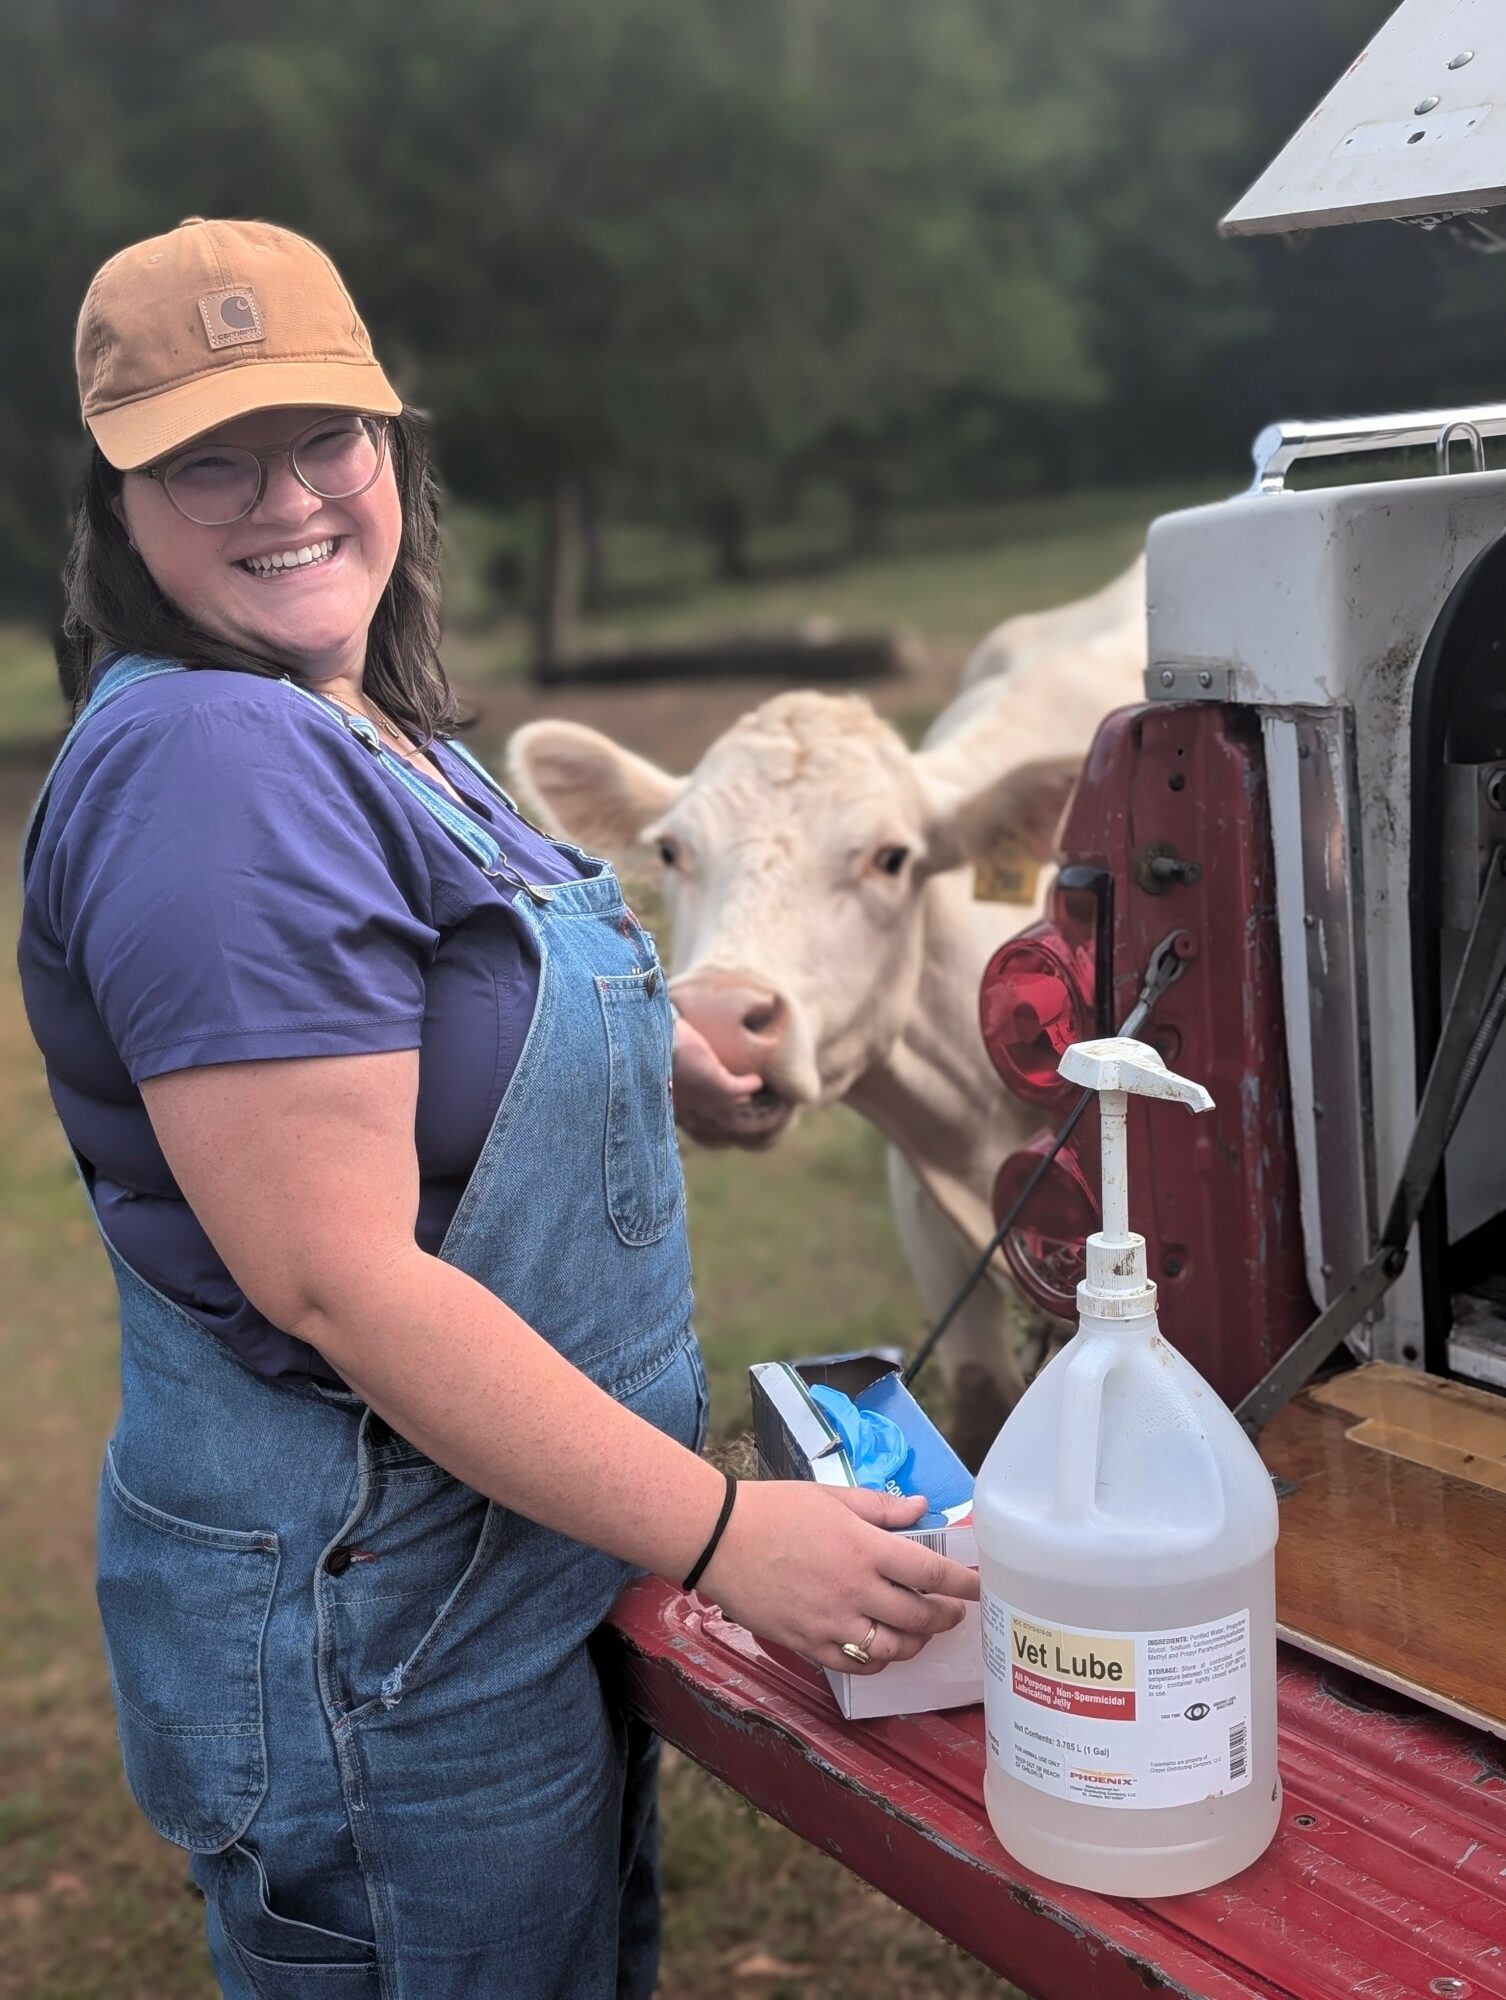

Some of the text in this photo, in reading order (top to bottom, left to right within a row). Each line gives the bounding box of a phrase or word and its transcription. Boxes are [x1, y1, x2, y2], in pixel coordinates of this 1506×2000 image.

[1190, 1632, 1210, 1641] Purified
[1170, 1644, 1191, 1652] Sodium
[1013, 1630, 1047, 1668] Vet
[1056, 1646, 1122, 1681] Lube
[1180, 1650, 1197, 1658] Propyl
[1148, 1667, 1178, 1675] STORAGE:
[1148, 1673, 1180, 1682] temperature
[1182, 1671, 1203, 1679] between
[1015, 1671, 1125, 1706] All Purpose, Non-Spermicidal
[1167, 1680, 1193, 1688] container
[1015, 1681, 1071, 1710] Lubricating Jelly
[1014, 1721, 1110, 1758] Net Contents: 3.785 L (1 Gal)
[1070, 1772, 1133, 1785] PHOENIX
